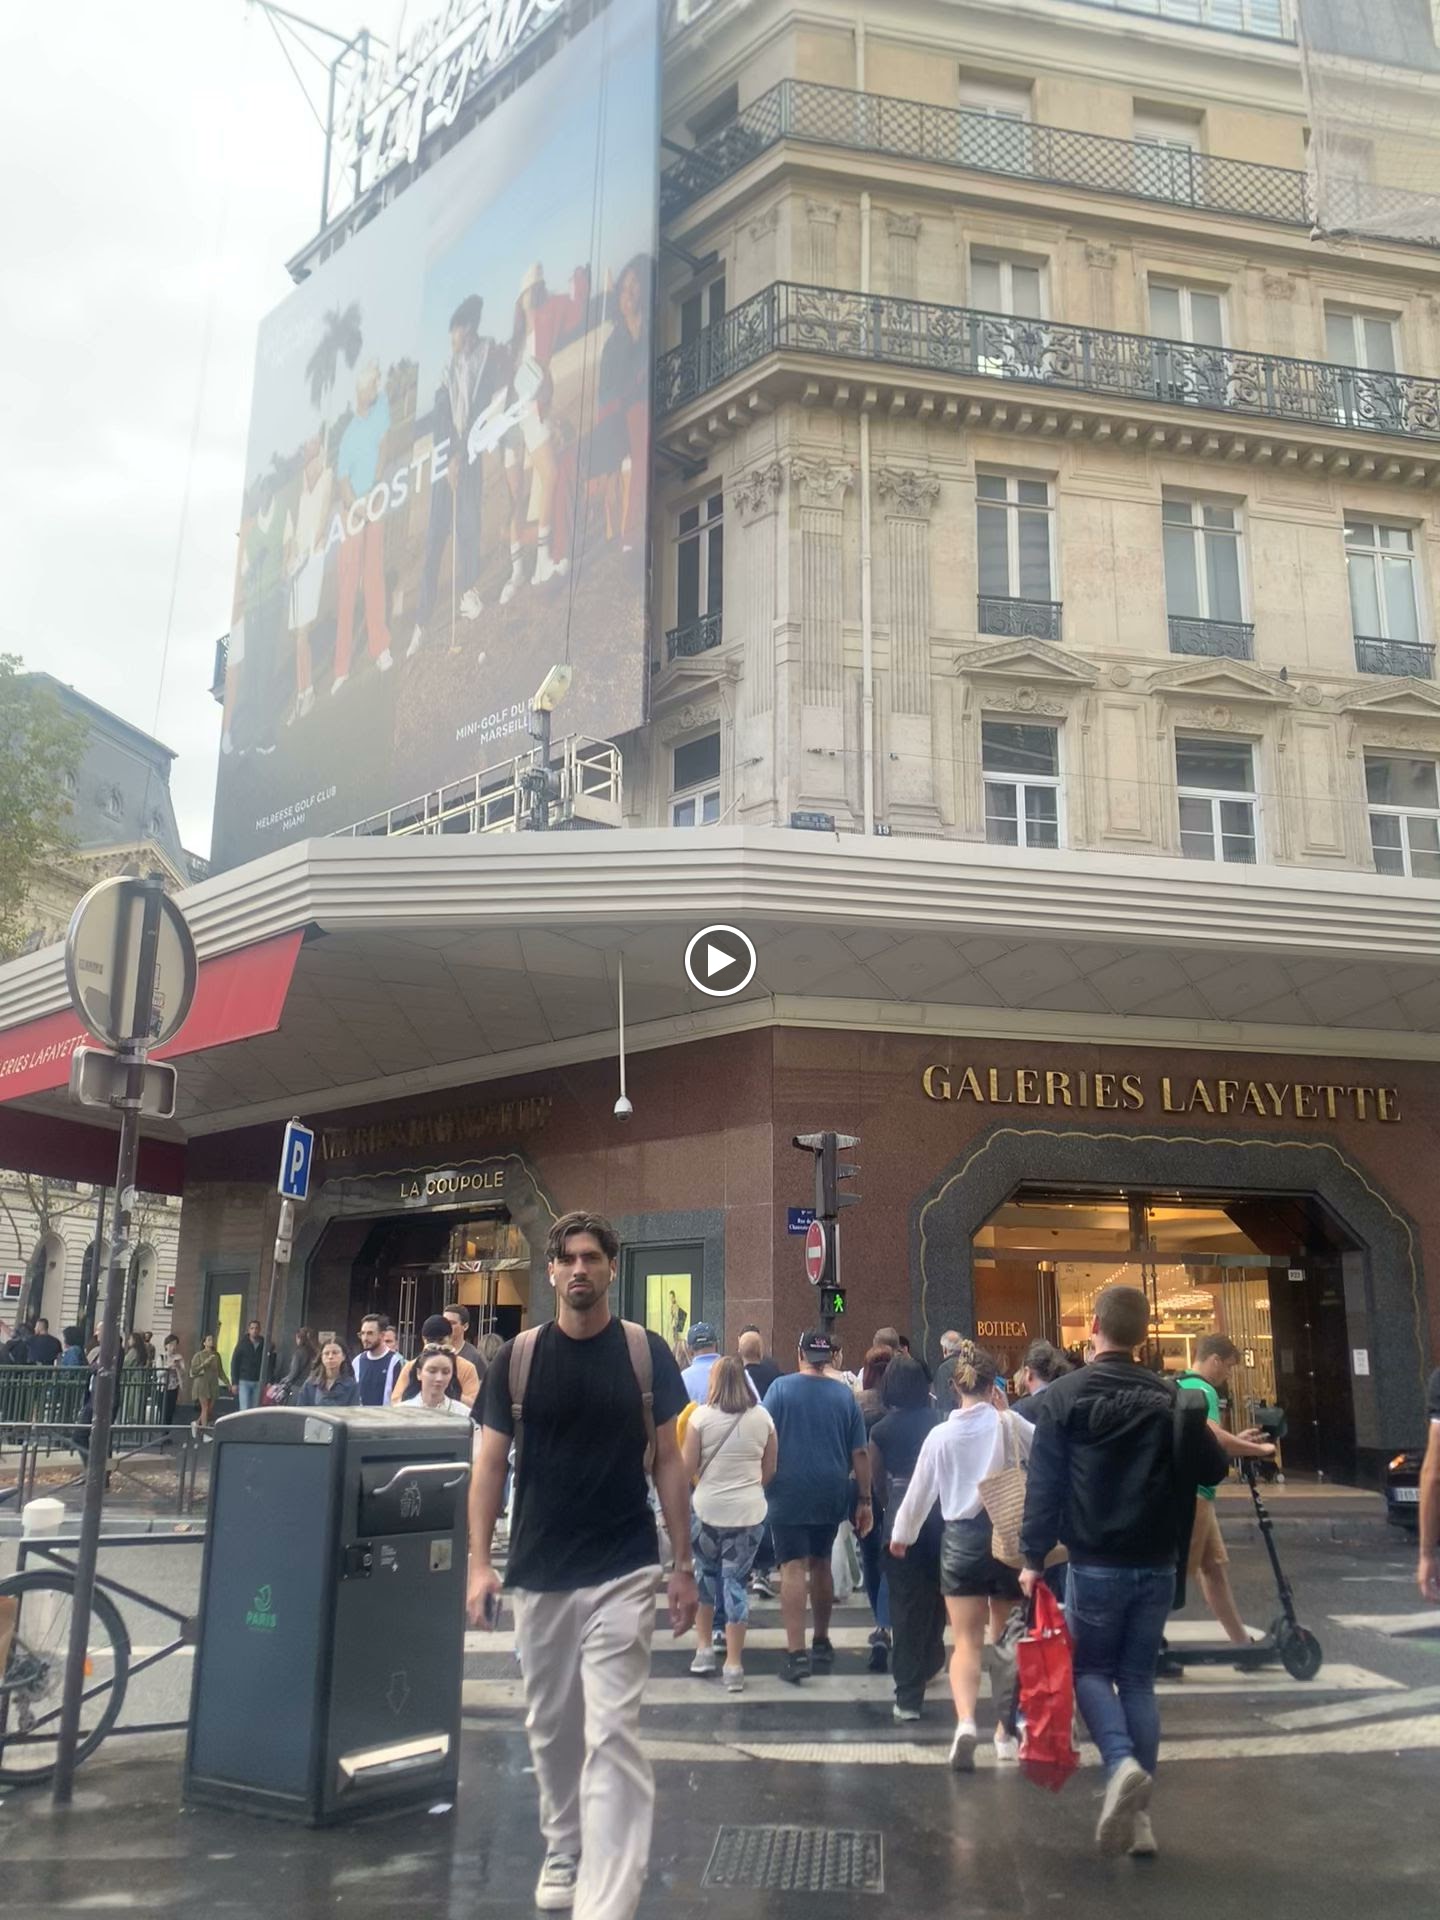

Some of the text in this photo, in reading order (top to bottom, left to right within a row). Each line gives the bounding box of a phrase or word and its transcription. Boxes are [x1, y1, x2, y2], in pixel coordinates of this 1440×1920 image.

[324, 436, 451, 554] ACOSTE
[455, 707, 509, 742] MINI-GOLF
[511, 700, 525, 718] DU
[480, 714, 528, 745] MARSEILL
[294, 794, 316, 813] GOLF
[316, 784, 337, 803] CLUB
[0, 1031, 90, 1078] ERIES LAFAYETTE
[922, 1063, 1402, 1122] GALERIES LAFAYETTE
[290, 1139, 305, 1184] P
[400, 1170, 505, 1199] LA COUPOLE
[977, 1320, 1028, 1337] BOTTEGA
[245, 1610, 277, 1628] PARIS
